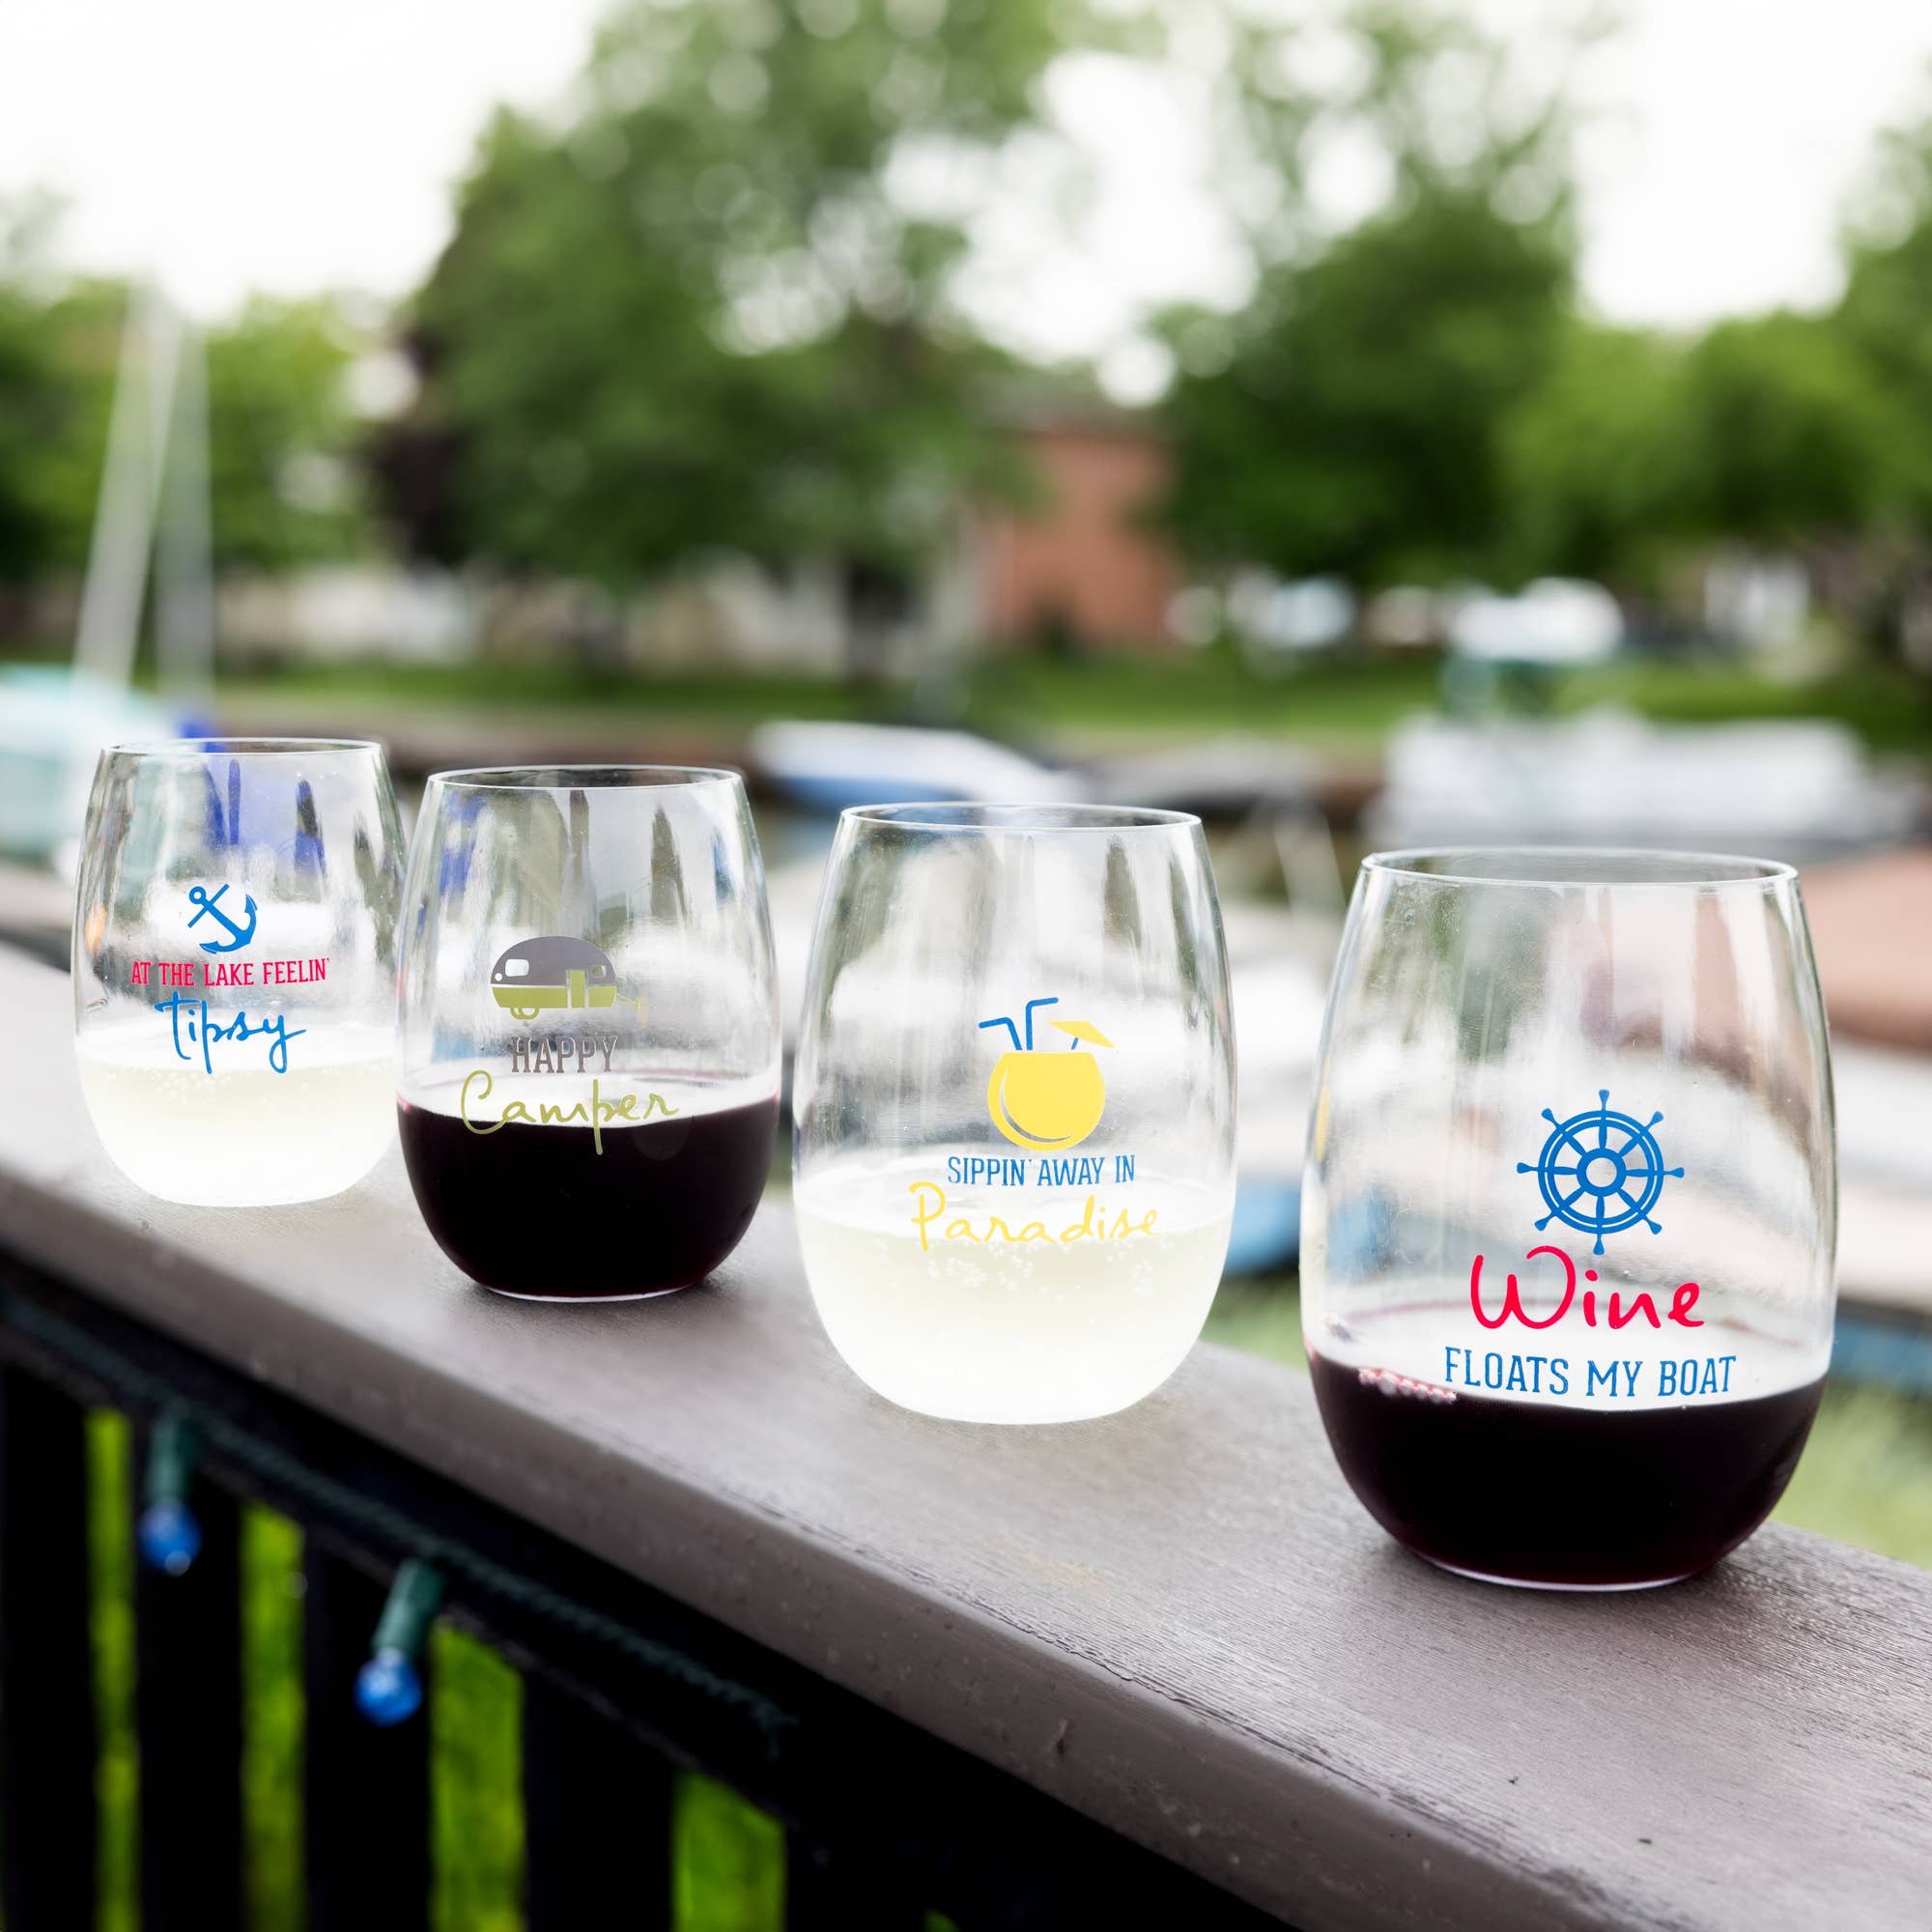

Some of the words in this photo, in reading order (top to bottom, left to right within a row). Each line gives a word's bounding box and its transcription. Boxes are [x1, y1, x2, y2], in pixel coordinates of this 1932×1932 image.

[131, 961, 152, 984] AT
[158, 961, 196, 985] THE
[204, 962, 254, 986] LAKE
[263, 957, 330, 984] FEELIN'
[155, 990, 307, 1074] Tipsy
[511, 1035, 618, 1073] HAPPY
[461, 1069, 680, 1155] Camper
[948, 1156, 1033, 1186] SIPPIN'
[1037, 1156, 1106, 1186] AWAY
[1115, 1154, 1136, 1183] IN
[909, 1180, 1159, 1252] Paradise
[1470, 1245, 1705, 1329] Wine
[1444, 1346, 1569, 1396] FLOATS
[1585, 1359, 1643, 1398] MY
[1658, 1354, 1737, 1397] BOAT
